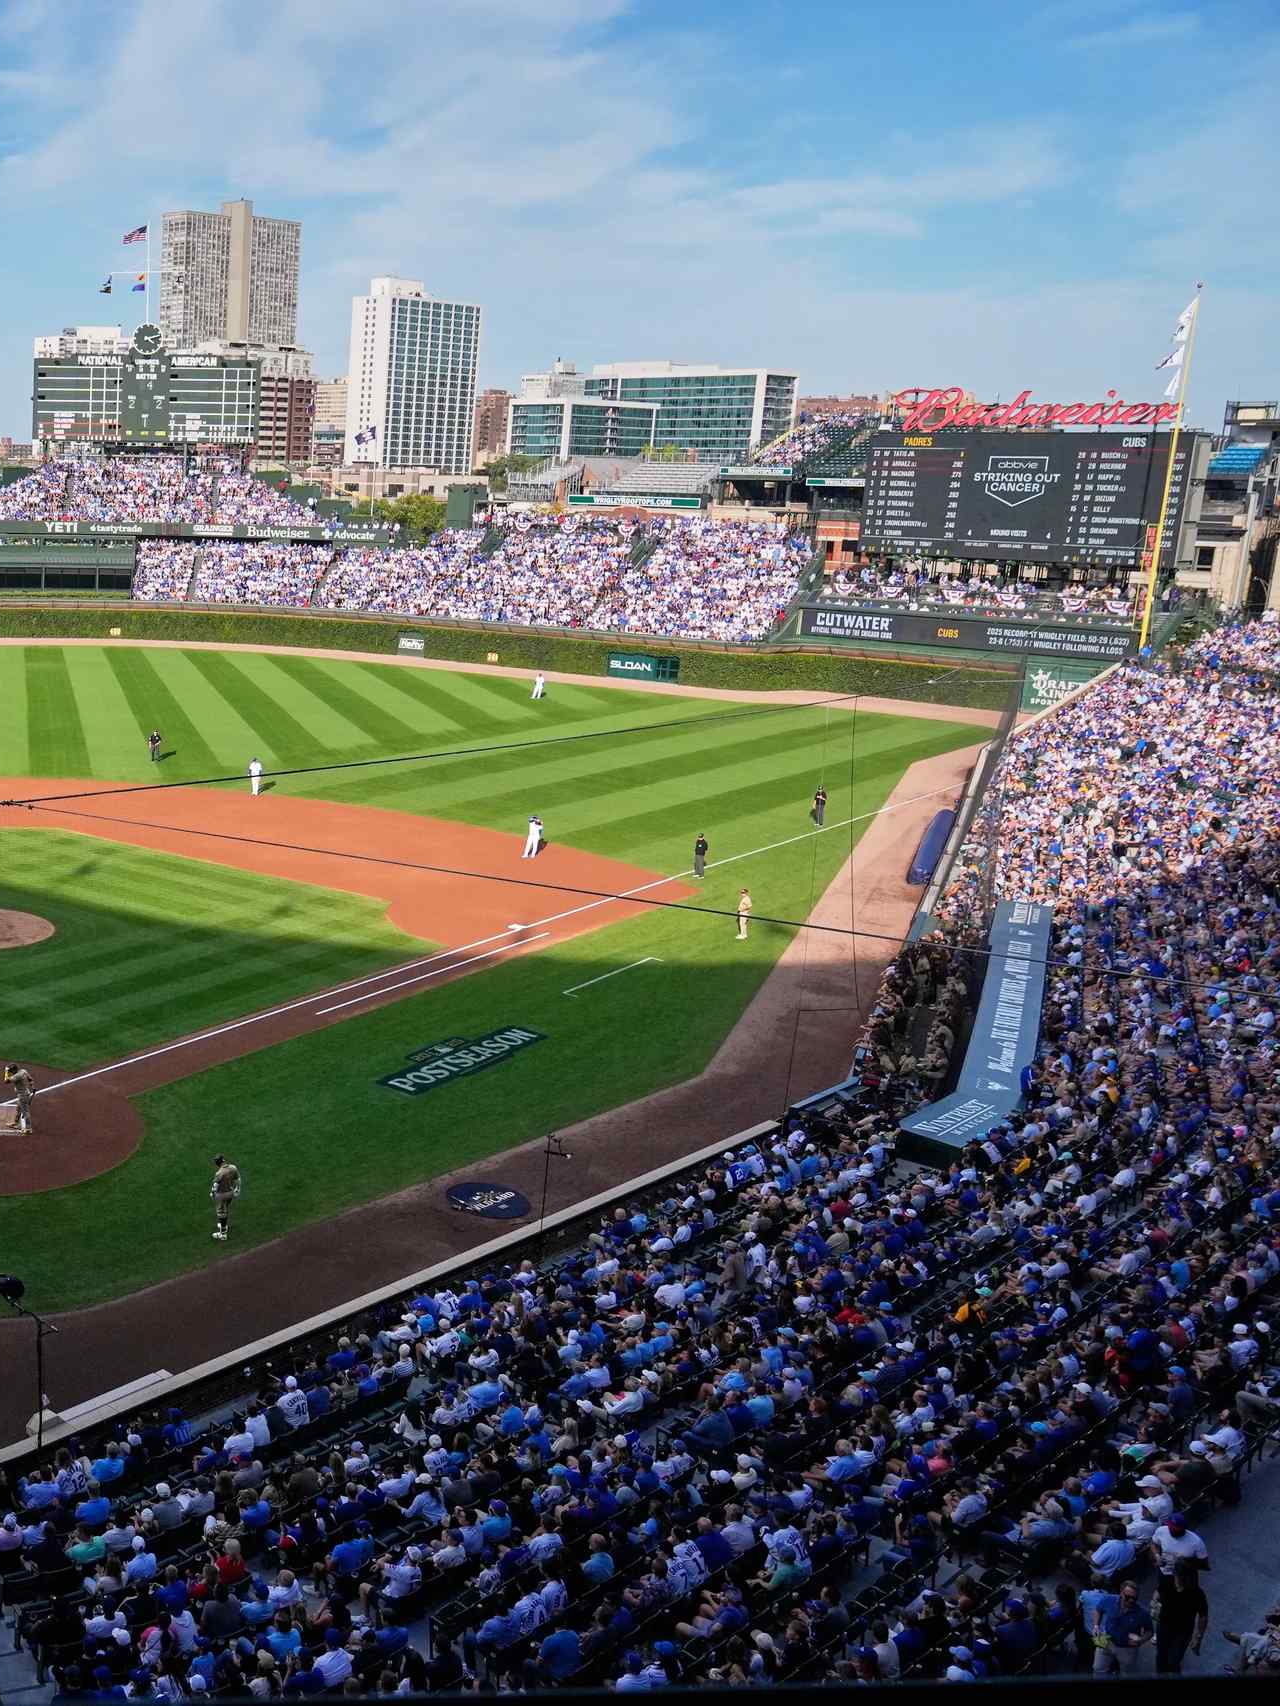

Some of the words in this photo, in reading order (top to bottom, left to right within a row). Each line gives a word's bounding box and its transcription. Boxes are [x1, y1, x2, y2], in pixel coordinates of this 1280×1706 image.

[77, 355, 124, 366] NATIONAL
[170, 356, 218, 367] AMERICAN
[128, 400, 136, 409] 2
[155, 400, 163, 409] 2
[894, 386, 1181, 432] Budweiser
[903, 437, 933, 447] PADRES
[1122, 437, 1147, 448] CUBS
[997, 461, 1039, 469] abbvie
[973, 472, 1033, 482] STRIKING
[1034, 473, 1061, 483] OUT
[990, 482, 1040, 492] CANCER
[44, 522, 78, 533] YETI
[333, 530, 376, 540] Advocate
[816, 612, 891, 631] CUTWATER
[937, 627, 960, 639] CUBS
[986, 627, 1003, 636] 2025
[1038, 632, 1067, 641] WRIGLEY
[1088, 635, 1109, 645] 50-29
[1033, 639, 1062, 649] WRIGLEY
[1062, 642, 1100, 654] FOLLOWING
[1100, 644, 1105, 654] A
[1105, 645, 1124, 656] LOSS
[387, 1028, 539, 1092] POSTSEASON
[911, 1098, 989, 1133] WINTRUST
